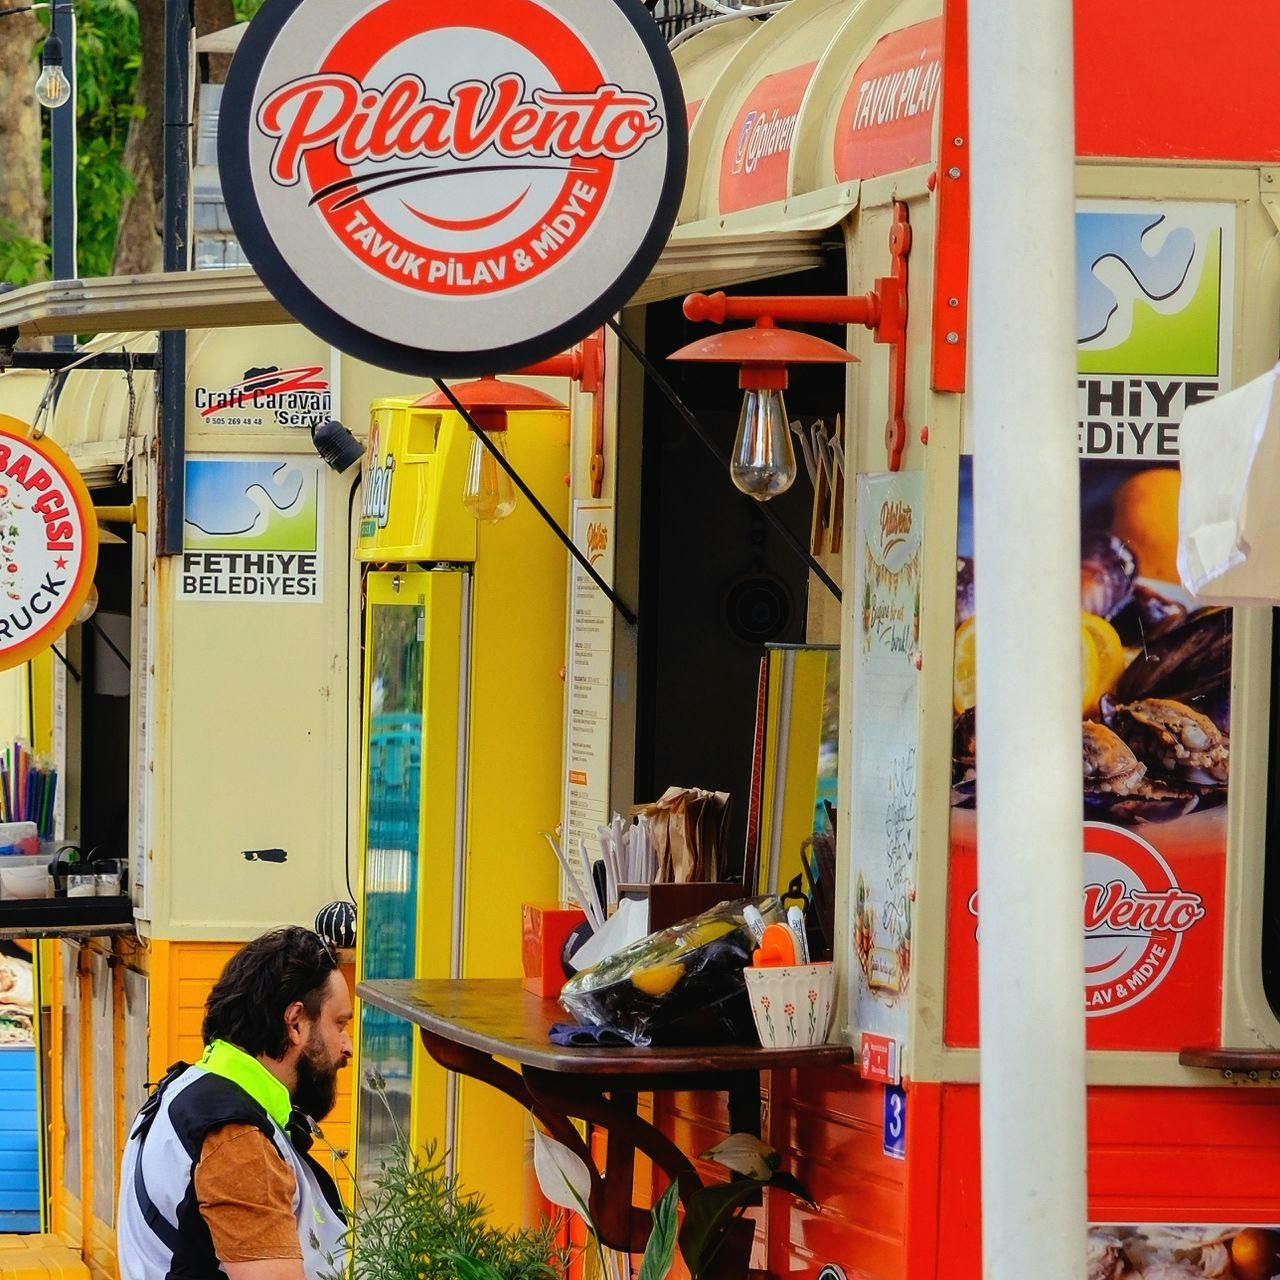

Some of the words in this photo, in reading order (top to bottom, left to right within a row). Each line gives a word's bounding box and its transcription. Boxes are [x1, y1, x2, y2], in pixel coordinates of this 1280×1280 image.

[853, 71, 905, 130] TAVUK
[260, 75, 661, 183] PilaVento
[344, 210, 426, 280] TAVUK
[428, 257, 506, 286] PİLAV
[512, 248, 534, 273] &
[529, 179, 597, 260] MİDYE
[195, 387, 246, 409] Craft
[253, 388, 332, 411] Caravan
[211, 417, 226, 425] 505
[227, 417, 241, 425] 269
[243, 417, 252, 425] 48
[254, 417, 263, 425] 48
[1115, 983, 1129, 998] &
[1126, 943, 1167, 991] MİDYE
[889, 1094, 902, 1138] 3
